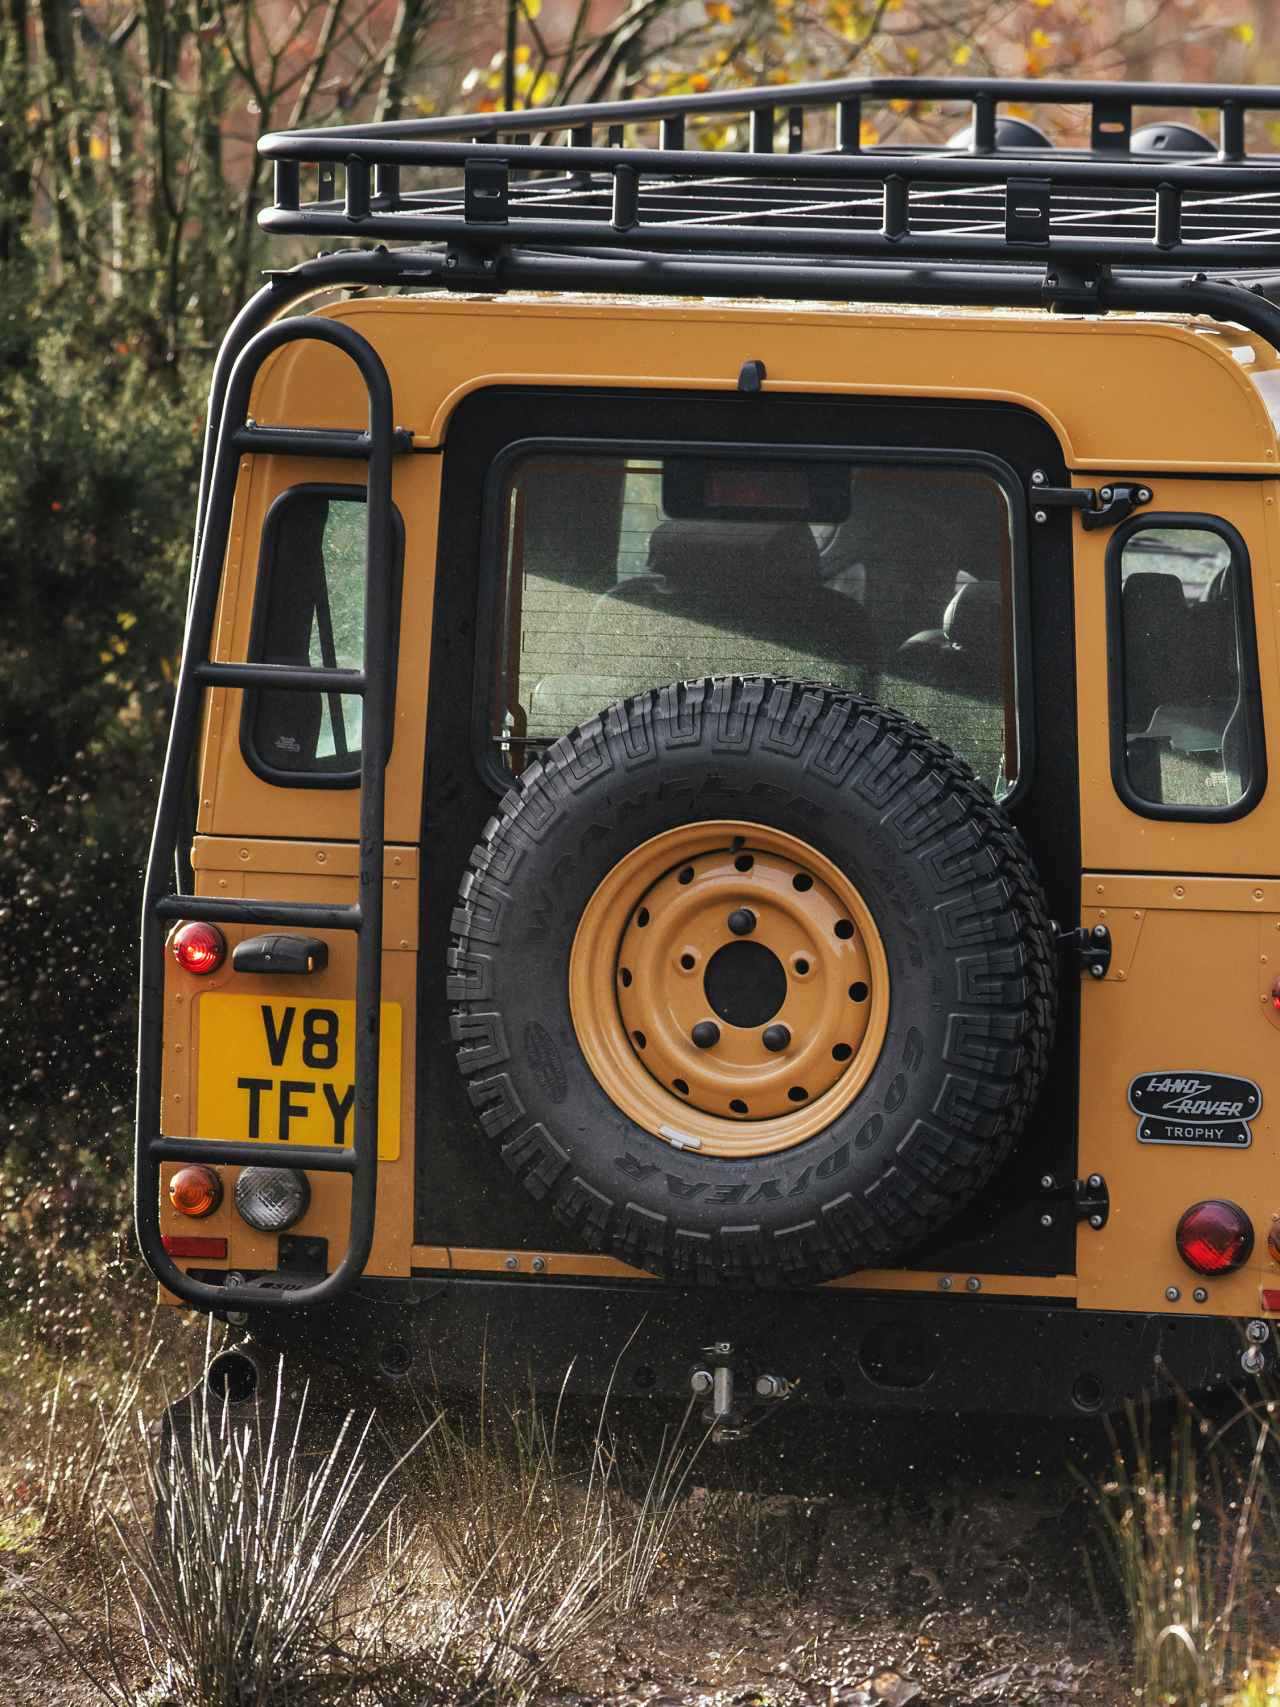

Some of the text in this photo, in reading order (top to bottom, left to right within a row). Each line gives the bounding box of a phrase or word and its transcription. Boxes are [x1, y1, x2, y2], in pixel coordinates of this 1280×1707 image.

[525, 774, 827, 943] WRANGLER
[261, 1005, 339, 1070] V8
[237, 1078, 355, 1144] TFY
[614, 1025, 923, 1204] GOODYEAR
[1146, 1078, 1202, 1093] LAND
[1175, 1100, 1243, 1116] ROVER
[1165, 1127, 1224, 1139] TROPHY
